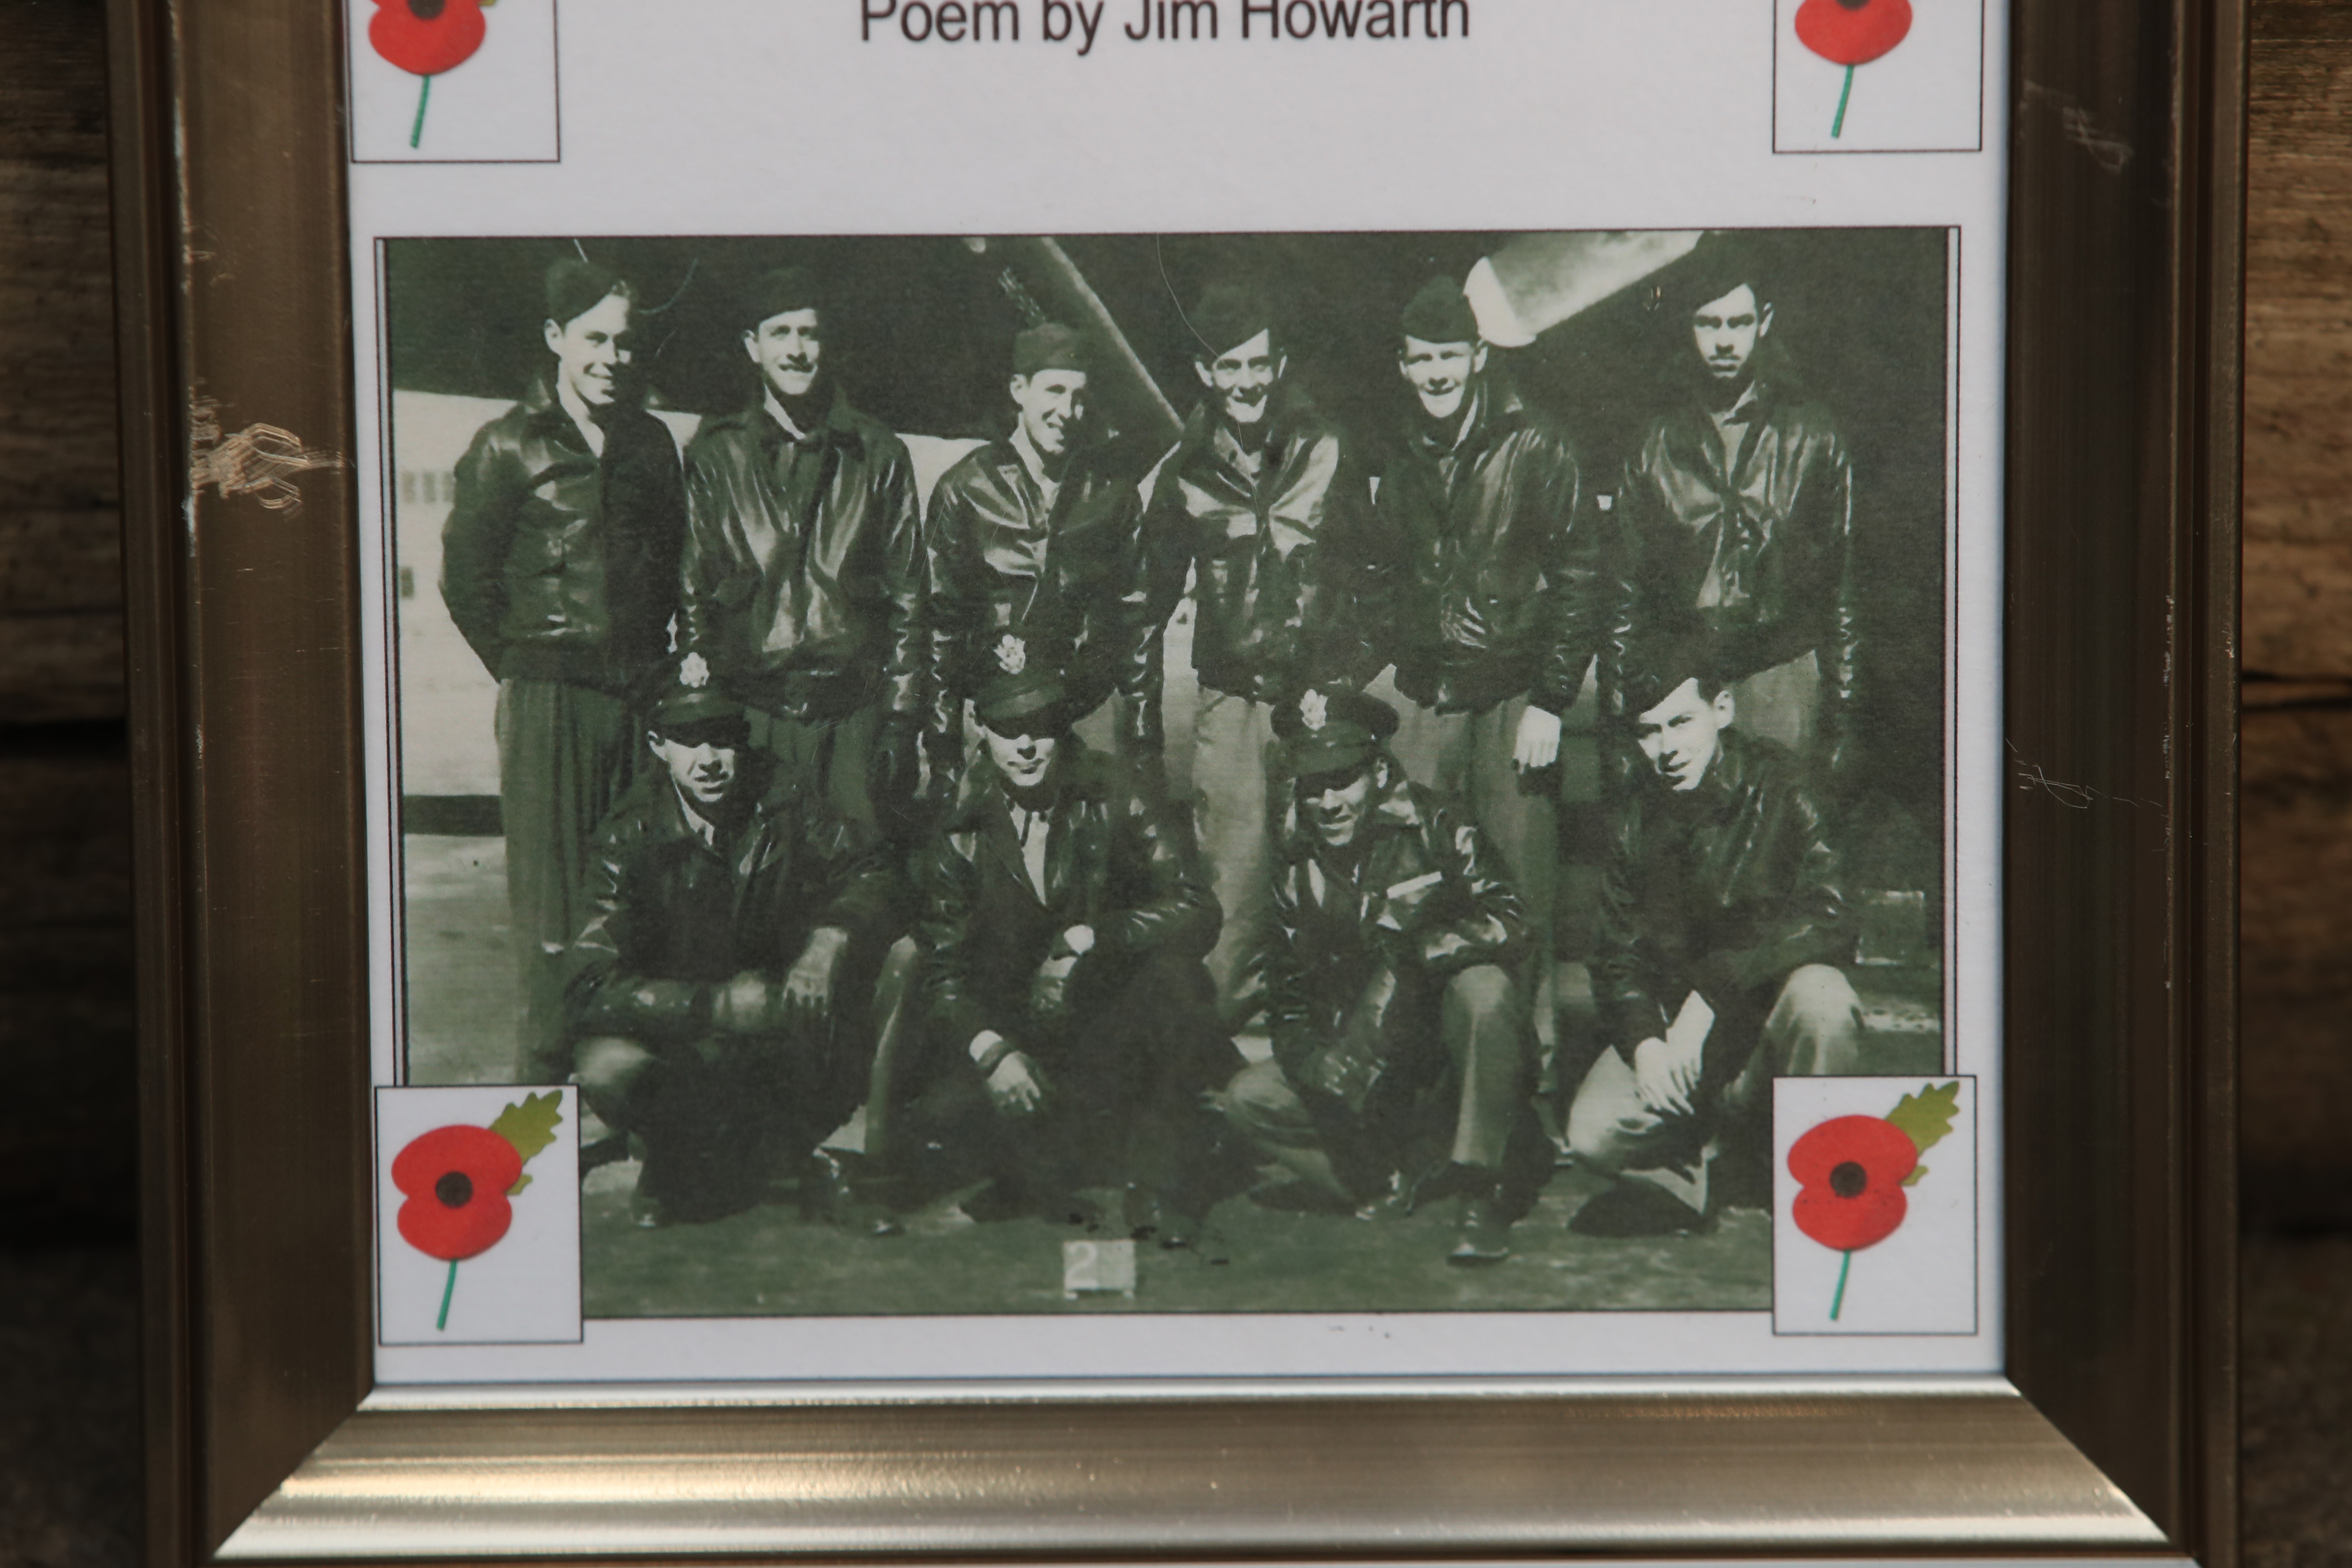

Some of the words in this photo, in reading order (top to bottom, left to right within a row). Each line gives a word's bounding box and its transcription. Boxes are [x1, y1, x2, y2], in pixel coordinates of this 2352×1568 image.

[861, 0, 1019, 42] Poem
[1042, 0, 1104, 56] by
[1124, 0, 1218, 41] Jim
[1241, 0, 1469, 39] Howarth
